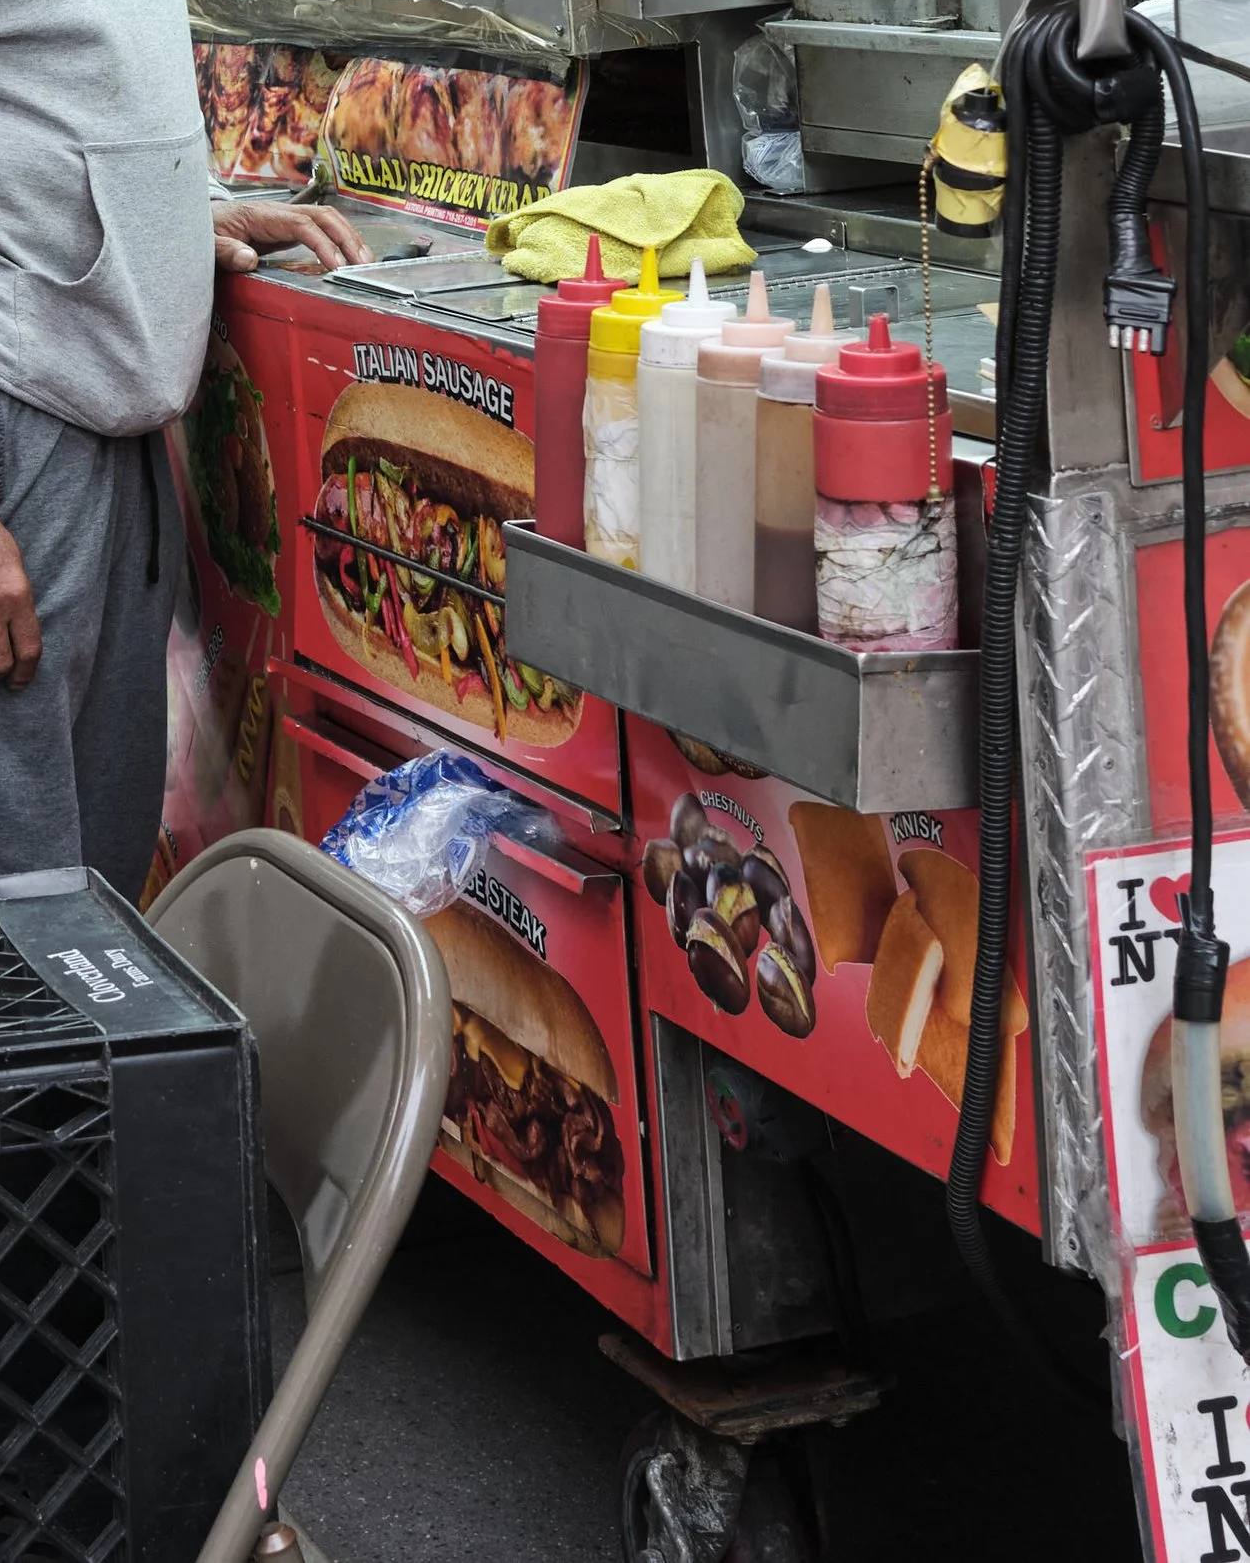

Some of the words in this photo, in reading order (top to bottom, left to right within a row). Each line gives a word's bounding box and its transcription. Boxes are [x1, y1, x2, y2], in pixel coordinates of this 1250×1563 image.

[336, 150, 406, 190] HALAL
[409, 162, 487, 211] CHICKEN
[405, 201, 424, 214] ASTORIA
[425, 205, 446, 220] PRINTING
[354, 345, 419, 382] ITALIAN
[422, 353, 512, 422] SAUSAGE
[700, 789, 764, 843] CHESTNUTS
[891, 817, 944, 846] KNISK
[490, 878, 546, 954] STEAK
[1116, 877, 1145, 931] I
[47, 949, 125, 1003] Cloverland
[104, 949, 133, 969] Dairy
[122, 966, 153, 988] Farms
[1197, 1395, 1238, 1480] I
